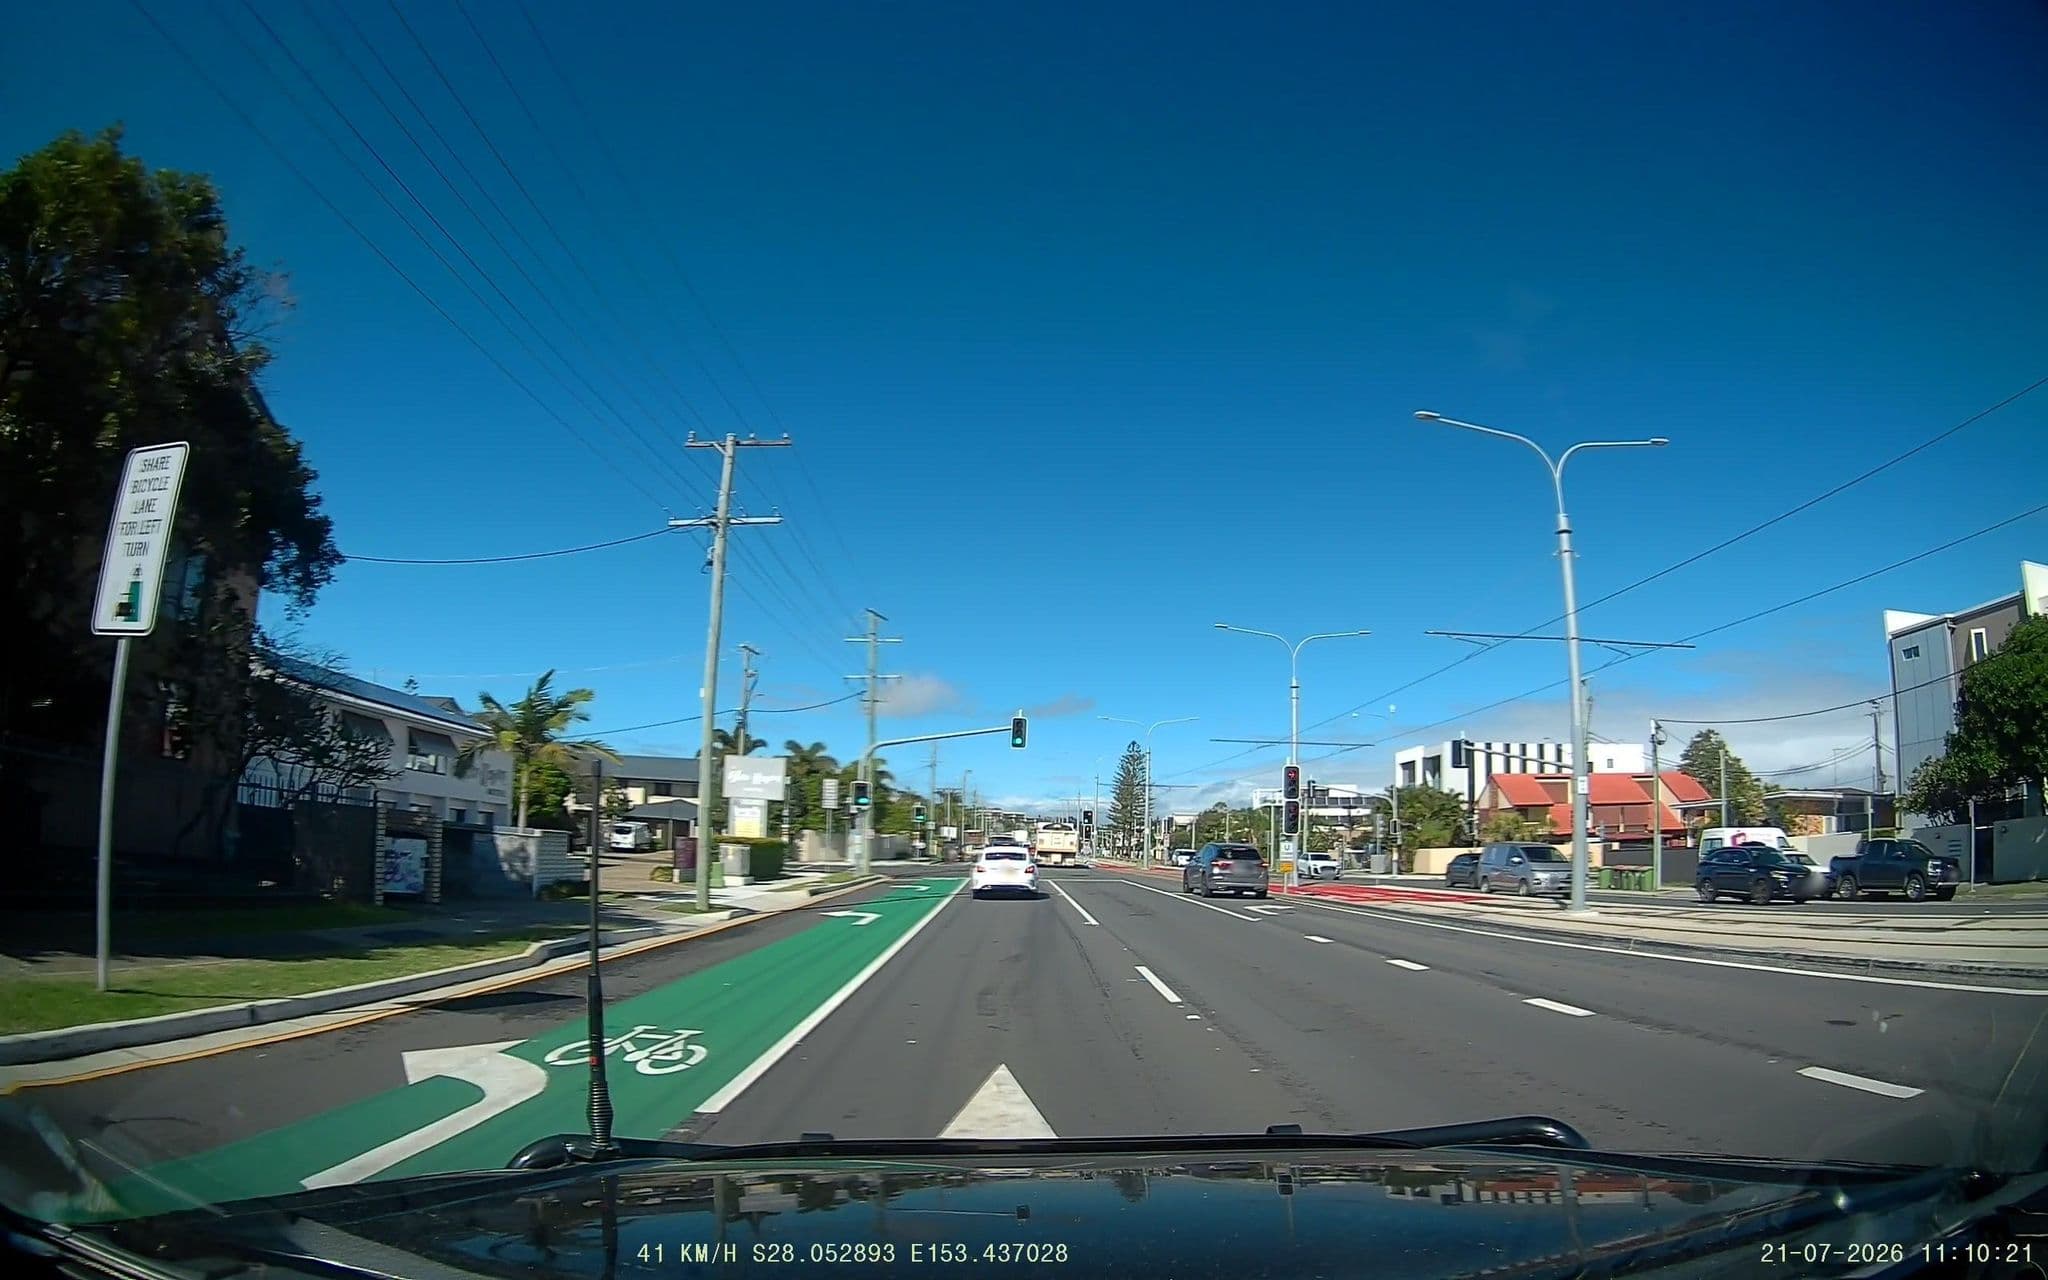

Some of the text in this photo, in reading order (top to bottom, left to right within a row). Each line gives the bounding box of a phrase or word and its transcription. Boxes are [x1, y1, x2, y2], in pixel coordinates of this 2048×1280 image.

[140, 456, 172, 473] SHARE
[130, 476, 171, 494] BICYCLE
[131, 498, 158, 514] LANE
[119, 519, 162, 536] FOR LEFT
[123, 541, 150, 557] TURN
